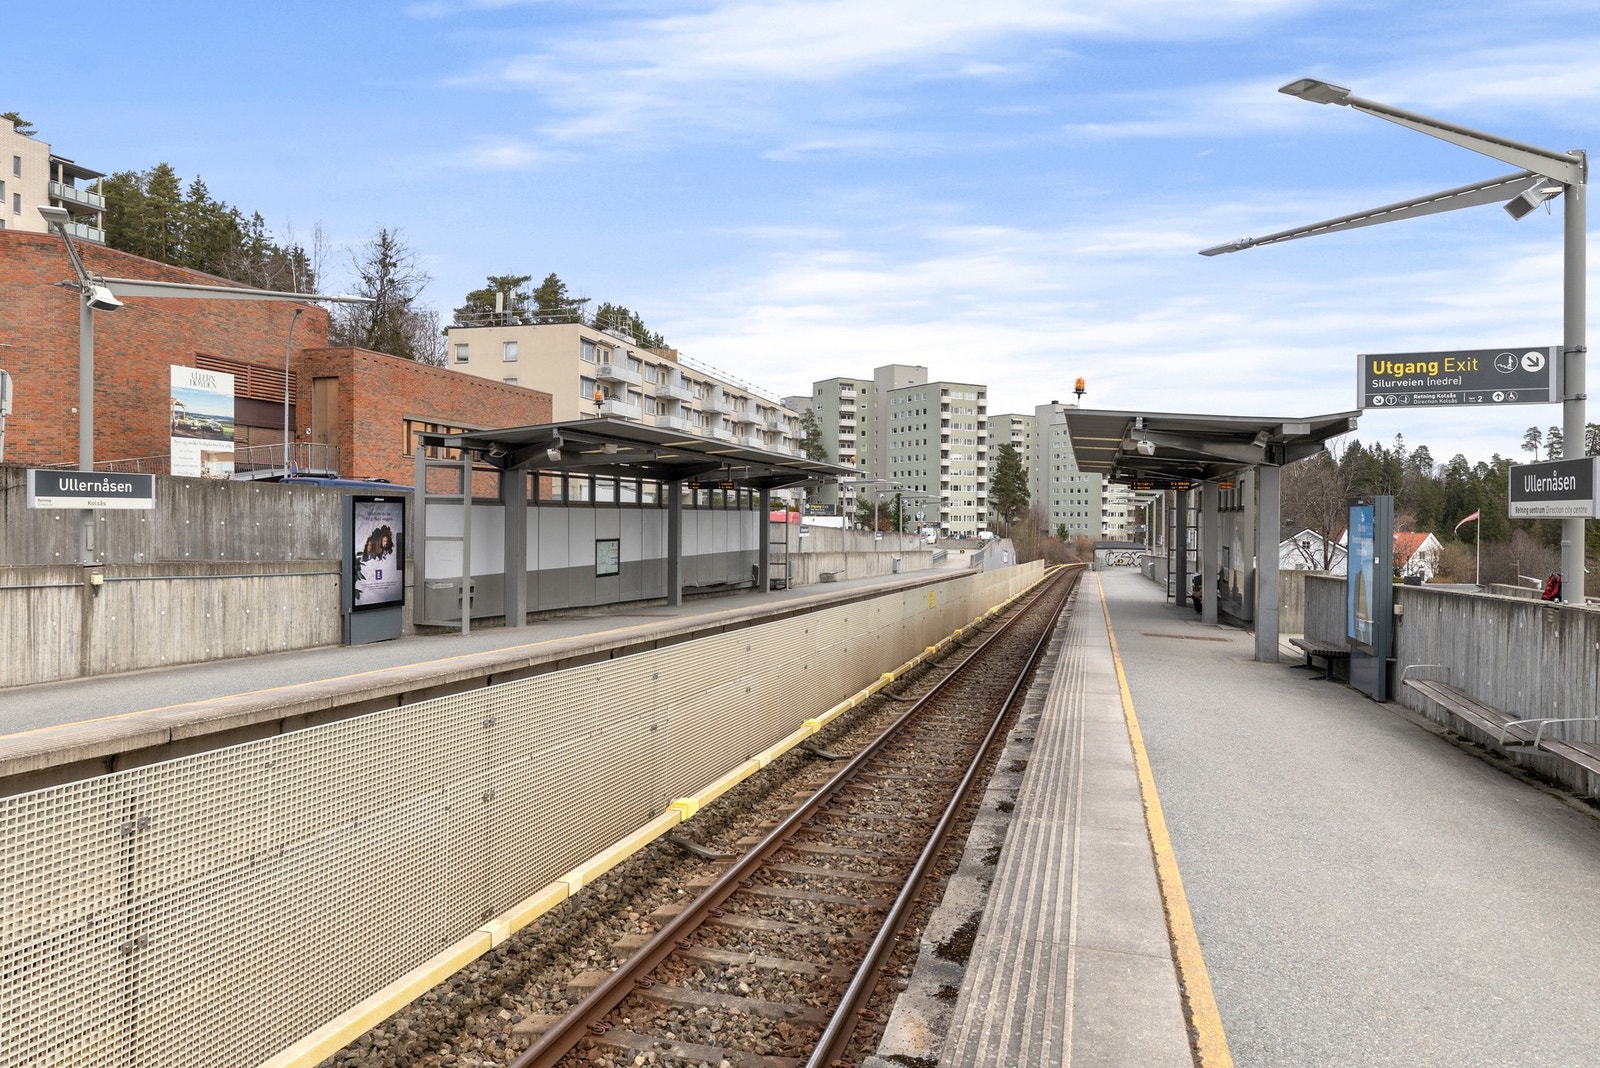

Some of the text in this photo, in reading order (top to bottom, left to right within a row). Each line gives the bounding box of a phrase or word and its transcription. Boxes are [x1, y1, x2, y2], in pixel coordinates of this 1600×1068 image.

[1372, 357, 1479, 377] Utgang Exit
[1372, 376, 1462, 388] Silurveien (nedre)
[59, 478, 133, 492] Ullernåsen
[1524, 470, 1576, 492] Ullernåsen
